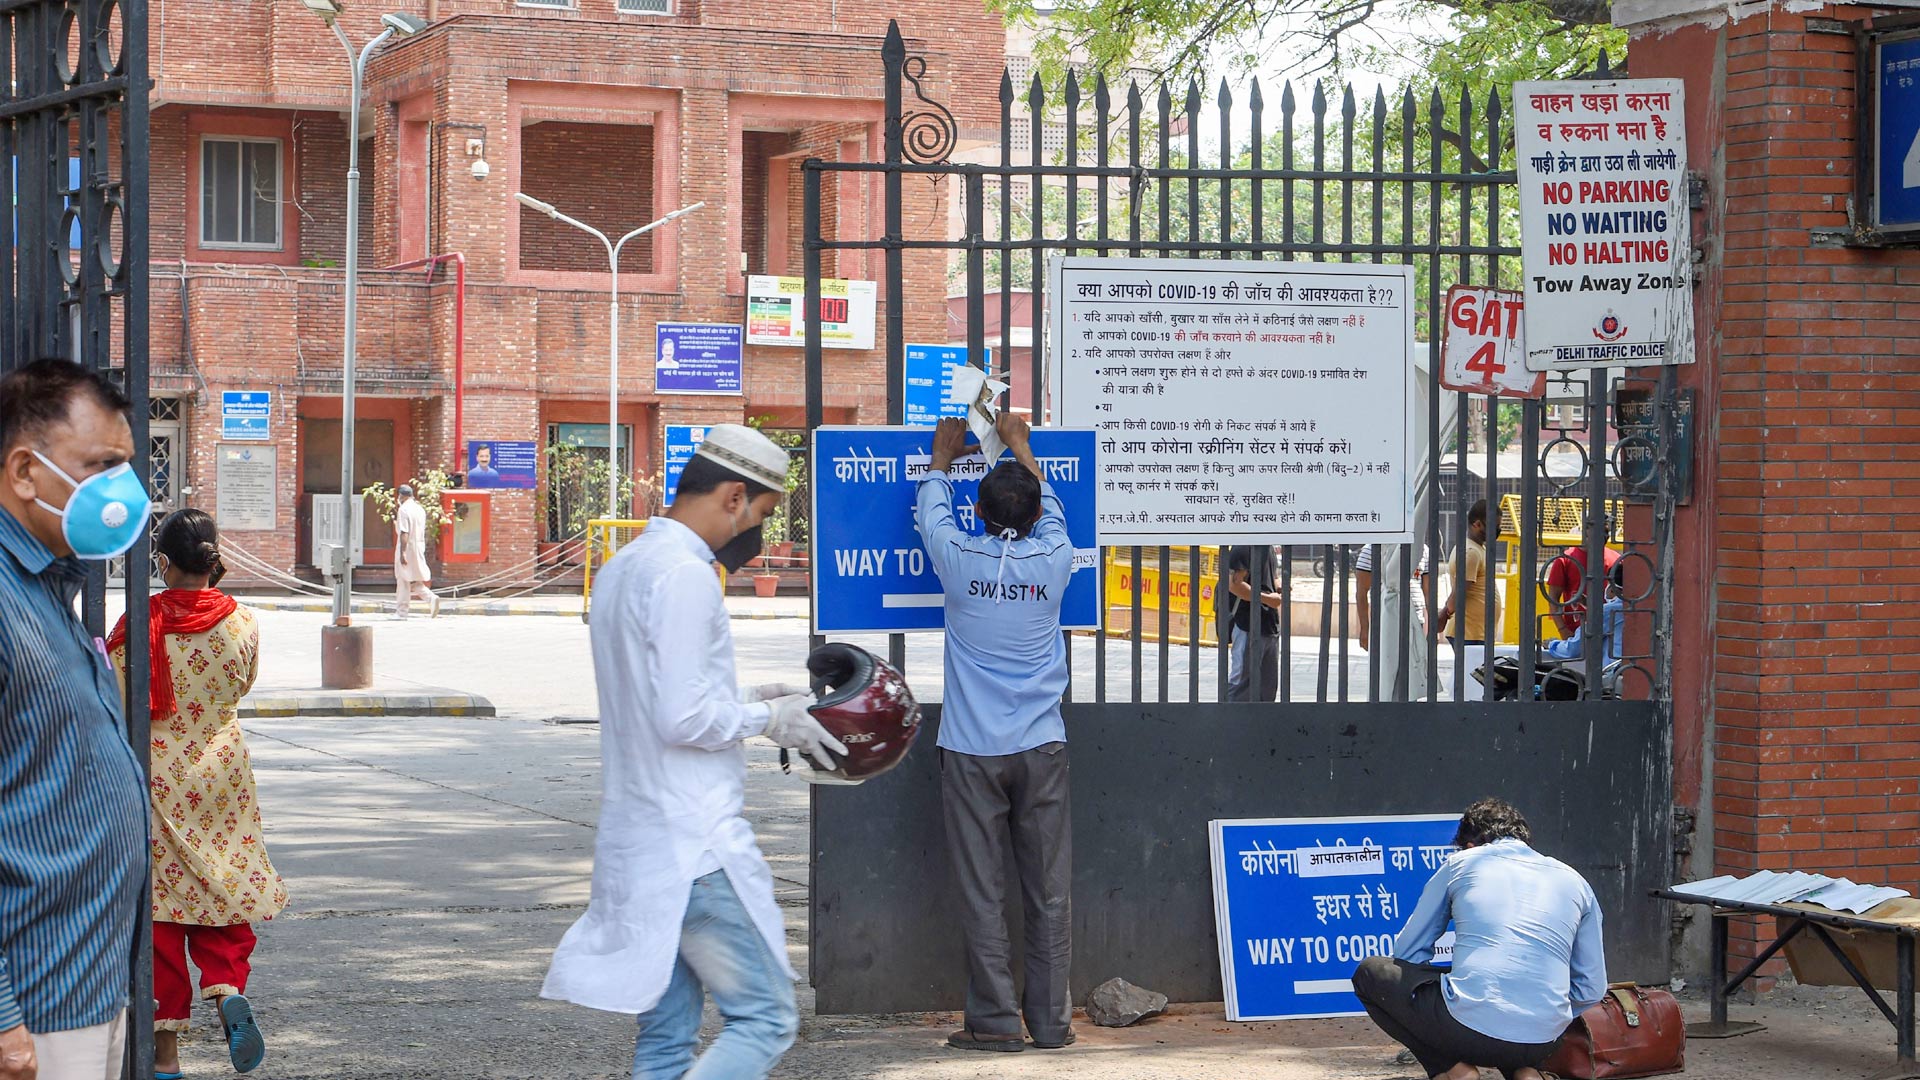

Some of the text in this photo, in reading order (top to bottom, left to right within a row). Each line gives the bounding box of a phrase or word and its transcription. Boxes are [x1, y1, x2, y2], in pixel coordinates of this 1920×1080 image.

[1530, 92, 1671, 114] वाहन खड़ा करना
[1537, 115, 1667, 142] व रुकना मना है
[1531, 148, 1677, 174] गाड़ी क्रेन द्वारा उठा ली जायेगी
[1543, 179, 1670, 205] NO PARKING
[1548, 210, 1668, 236] NO WAITING
[1548, 240, 1669, 266] NO HALTING
[1077, 280, 1394, 304] क्या आपको COVID-19 की जाँच की आवश्यकता है??
[1533, 273, 1687, 295] Tow Away Zone
[1083, 310, 1103, 323] यदि
[1104, 311, 1137, 324] आपको
[1169, 311, 1196, 326] बुखार
[1197, 314, 1209, 325] या
[1234, 312, 1250, 325] लेने
[1251, 312, 1260, 325] में
[1262, 313, 1296, 326] कठिनाई
[1297, 313, 1316, 326] जैसे
[1316, 314, 1341, 326] लक्षण
[1341, 313, 1357, 327] नहीं
[1451, 296, 1524, 341] GAT
[1082, 329, 1094, 342] तो
[1097, 329, 1129, 342] आपको
[1130, 331, 1171, 343] COVID-19
[1173, 330, 1186, 343] की
[1212, 330, 1242, 343] करवाने
[1244, 331, 1258, 344] की
[1259, 333, 1307, 344] आवश्यकता
[1308, 331, 1324, 344] नहीं
[1071, 347, 1082, 358] 2.
[1084, 346, 1103, 358] यदि
[1104, 346, 1137, 358] आपको
[1138, 347, 1176, 359] उपरोक्त
[1176, 348, 1203, 359] लक्षण
[1213, 347, 1233, 359] और
[1556, 347, 1585, 361] DELHI
[1588, 345, 1628, 359] TRAFFIC
[1630, 343, 1665, 357] POLICE
[1101, 366, 1128, 378] आपने
[1130, 368, 1157, 378] लक्षण
[1158, 367, 1179, 381] शुरू
[1180, 366, 1198, 378] होने
[1199, 367, 1209, 379] से
[1211, 367, 1223, 379] दो
[1246, 367, 1257, 379] के
[1258, 367, 1279, 379] अंदर
[1280, 368, 1318, 379] COVID-19
[1319, 366, 1351, 379] प्रभावित
[1353, 366, 1368, 379] देश
[1466, 342, 1505, 386] 4
[1101, 382, 1166, 395] की यात्रा की है
[1101, 402, 1114, 412] या
[1101, 419, 1121, 431] आप
[1122, 418, 1148, 431] किसी
[1150, 419, 1191, 432] COVID-19
[1192, 418, 1212, 431] रोगी
[1213, 418, 1225, 431] के
[1226, 418, 1253, 431] निकट
[1253, 418, 1278, 431] संपर्क
[1279, 418, 1288, 432] में
[1289, 419, 1308, 432] आये
[1100, 437, 1353, 454] तो आप कोरोना स्क्रीनिंग सेंटर में संपर्क करें।
[833, 446, 898, 483] कोरोना
[1104, 461, 1136, 473] आपको
[1136, 461, 1174, 473] उपरोक्त
[1175, 462, 1201, 473] लक्षण
[1211, 461, 1236, 476] किन्तु
[1237, 464, 1256, 473] आप
[1257, 463, 1280, 473] ऊपर
[1280, 461, 1305, 473] लिखी
[1305, 461, 1325, 473] श्रेणी
[1365, 461, 1374, 473] में
[1375, 461, 1391, 473] नहीं
[1103, 479, 1116, 491] तो
[1136, 479, 1162, 491] कार्नर
[1163, 479, 1172, 491] में
[1173, 479, 1199, 491] संपर्क
[1200, 479, 1220, 491] करें।
[1184, 494, 1221, 505] सावधान
[1241, 492, 1275, 508] सुरक्षित
[1155, 511, 1196, 523] अस्पताल
[1198, 510, 1226, 523] आपके
[1252, 512, 1277, 523] स्वस्थ
[1279, 510, 1297, 523] होने
[1298, 510, 1312, 523] की
[1313, 512, 1344, 523] कामना
[1344, 512, 1369, 523] करता
[1370, 510, 1382, 523] है।
[835, 549, 924, 577] WAY TO
[1239, 840, 1414, 876] कोरोना आपातकालीन का
[1312, 883, 1400, 926] इधर से है।
[1247, 937, 1295, 966] WAY
[1300, 936, 1330, 964] TO
